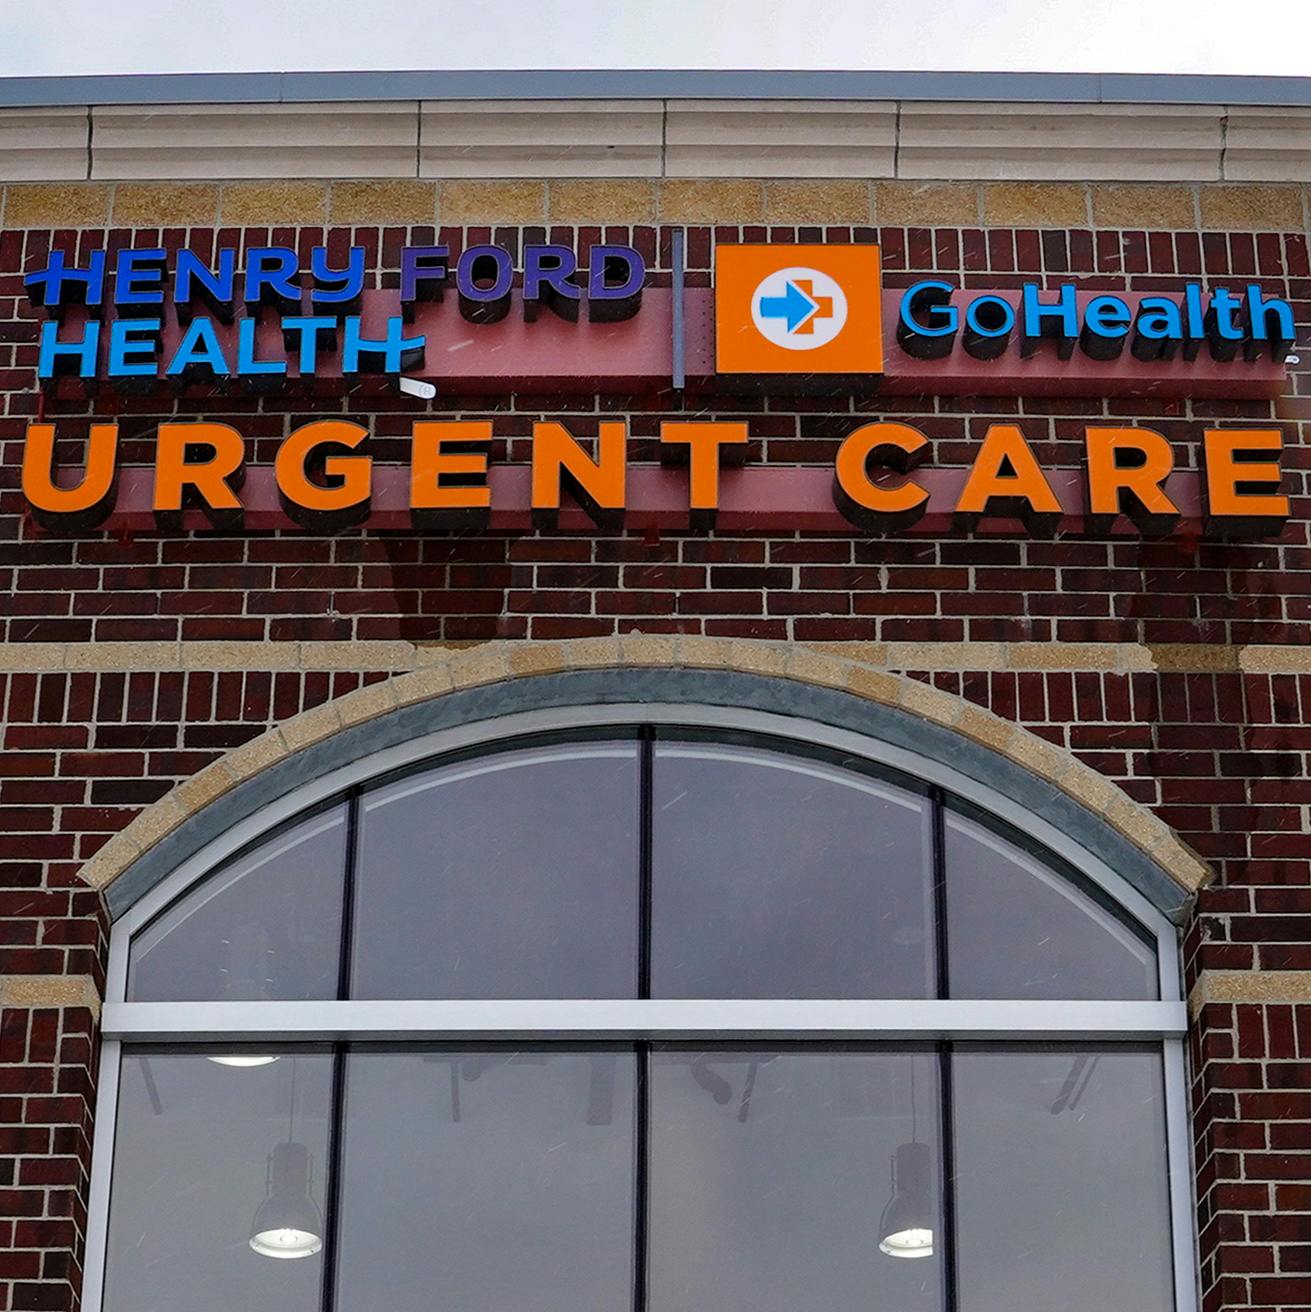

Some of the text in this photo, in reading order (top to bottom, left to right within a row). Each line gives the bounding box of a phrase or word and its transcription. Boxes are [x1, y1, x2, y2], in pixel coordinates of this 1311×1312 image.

[23, 243, 647, 305] HENRY FORD
[898, 279, 1297, 340] GoHealth
[37, 315, 427, 379] HEALTH
[19, 419, 1291, 517] URGENT CARE
